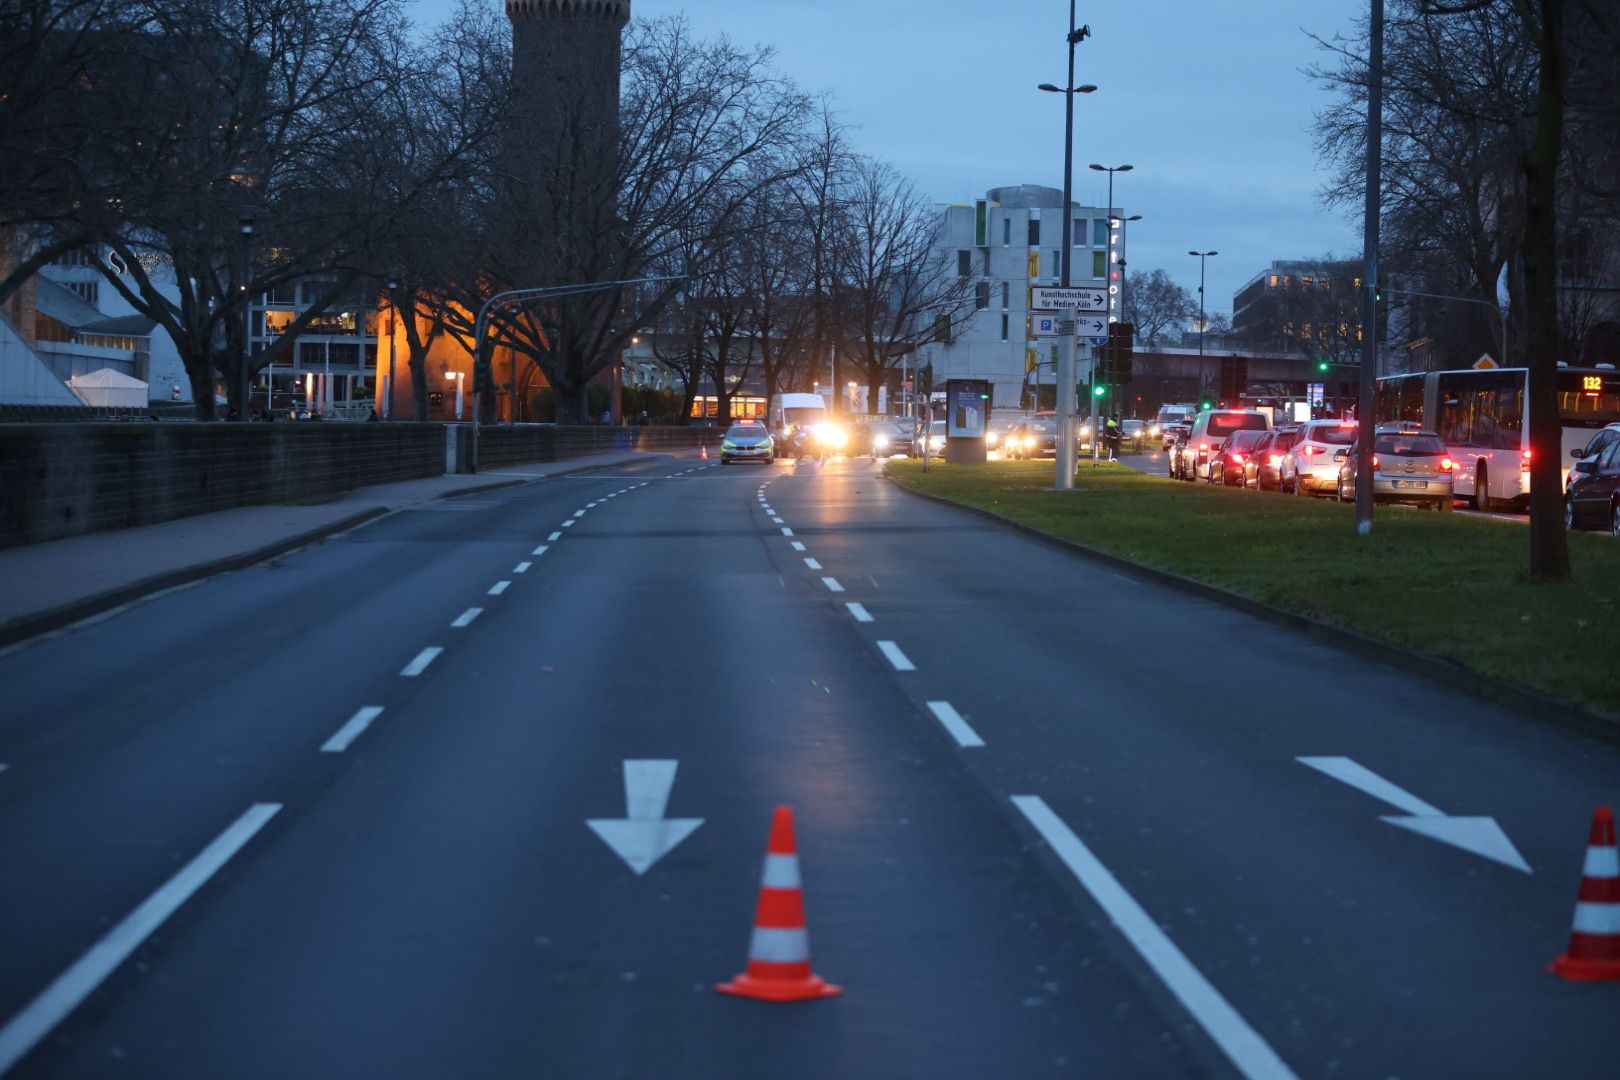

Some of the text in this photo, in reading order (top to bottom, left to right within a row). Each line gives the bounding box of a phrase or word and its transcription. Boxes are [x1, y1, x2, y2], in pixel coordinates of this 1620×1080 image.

[1040, 290, 1091, 299] Kunsthochschule
[1053, 300, 1075, 308] Medien
[1077, 300, 1091, 309] Köln
[1583, 376, 1601, 390] 132
